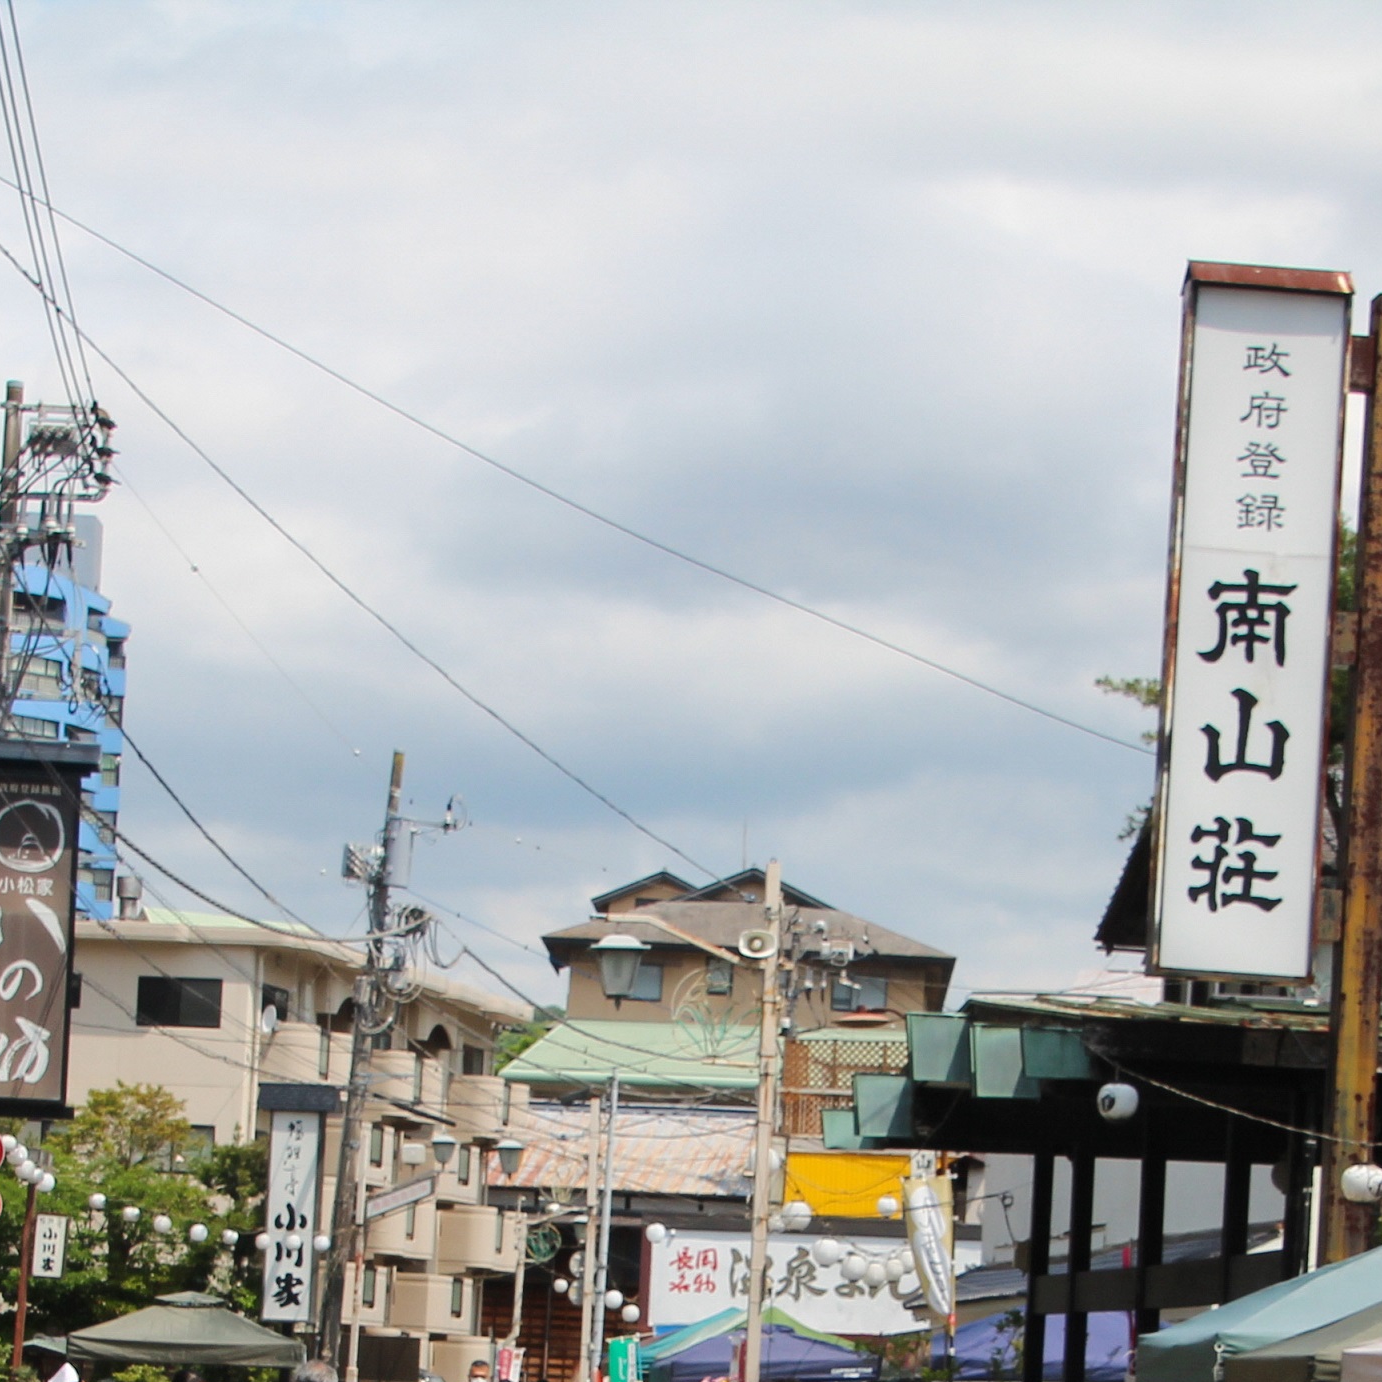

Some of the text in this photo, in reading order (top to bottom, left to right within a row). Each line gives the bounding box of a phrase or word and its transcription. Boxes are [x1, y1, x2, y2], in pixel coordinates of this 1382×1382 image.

[1235, 343, 1291, 531] 政府登録
[1187, 568, 1297, 911] 南山荘
